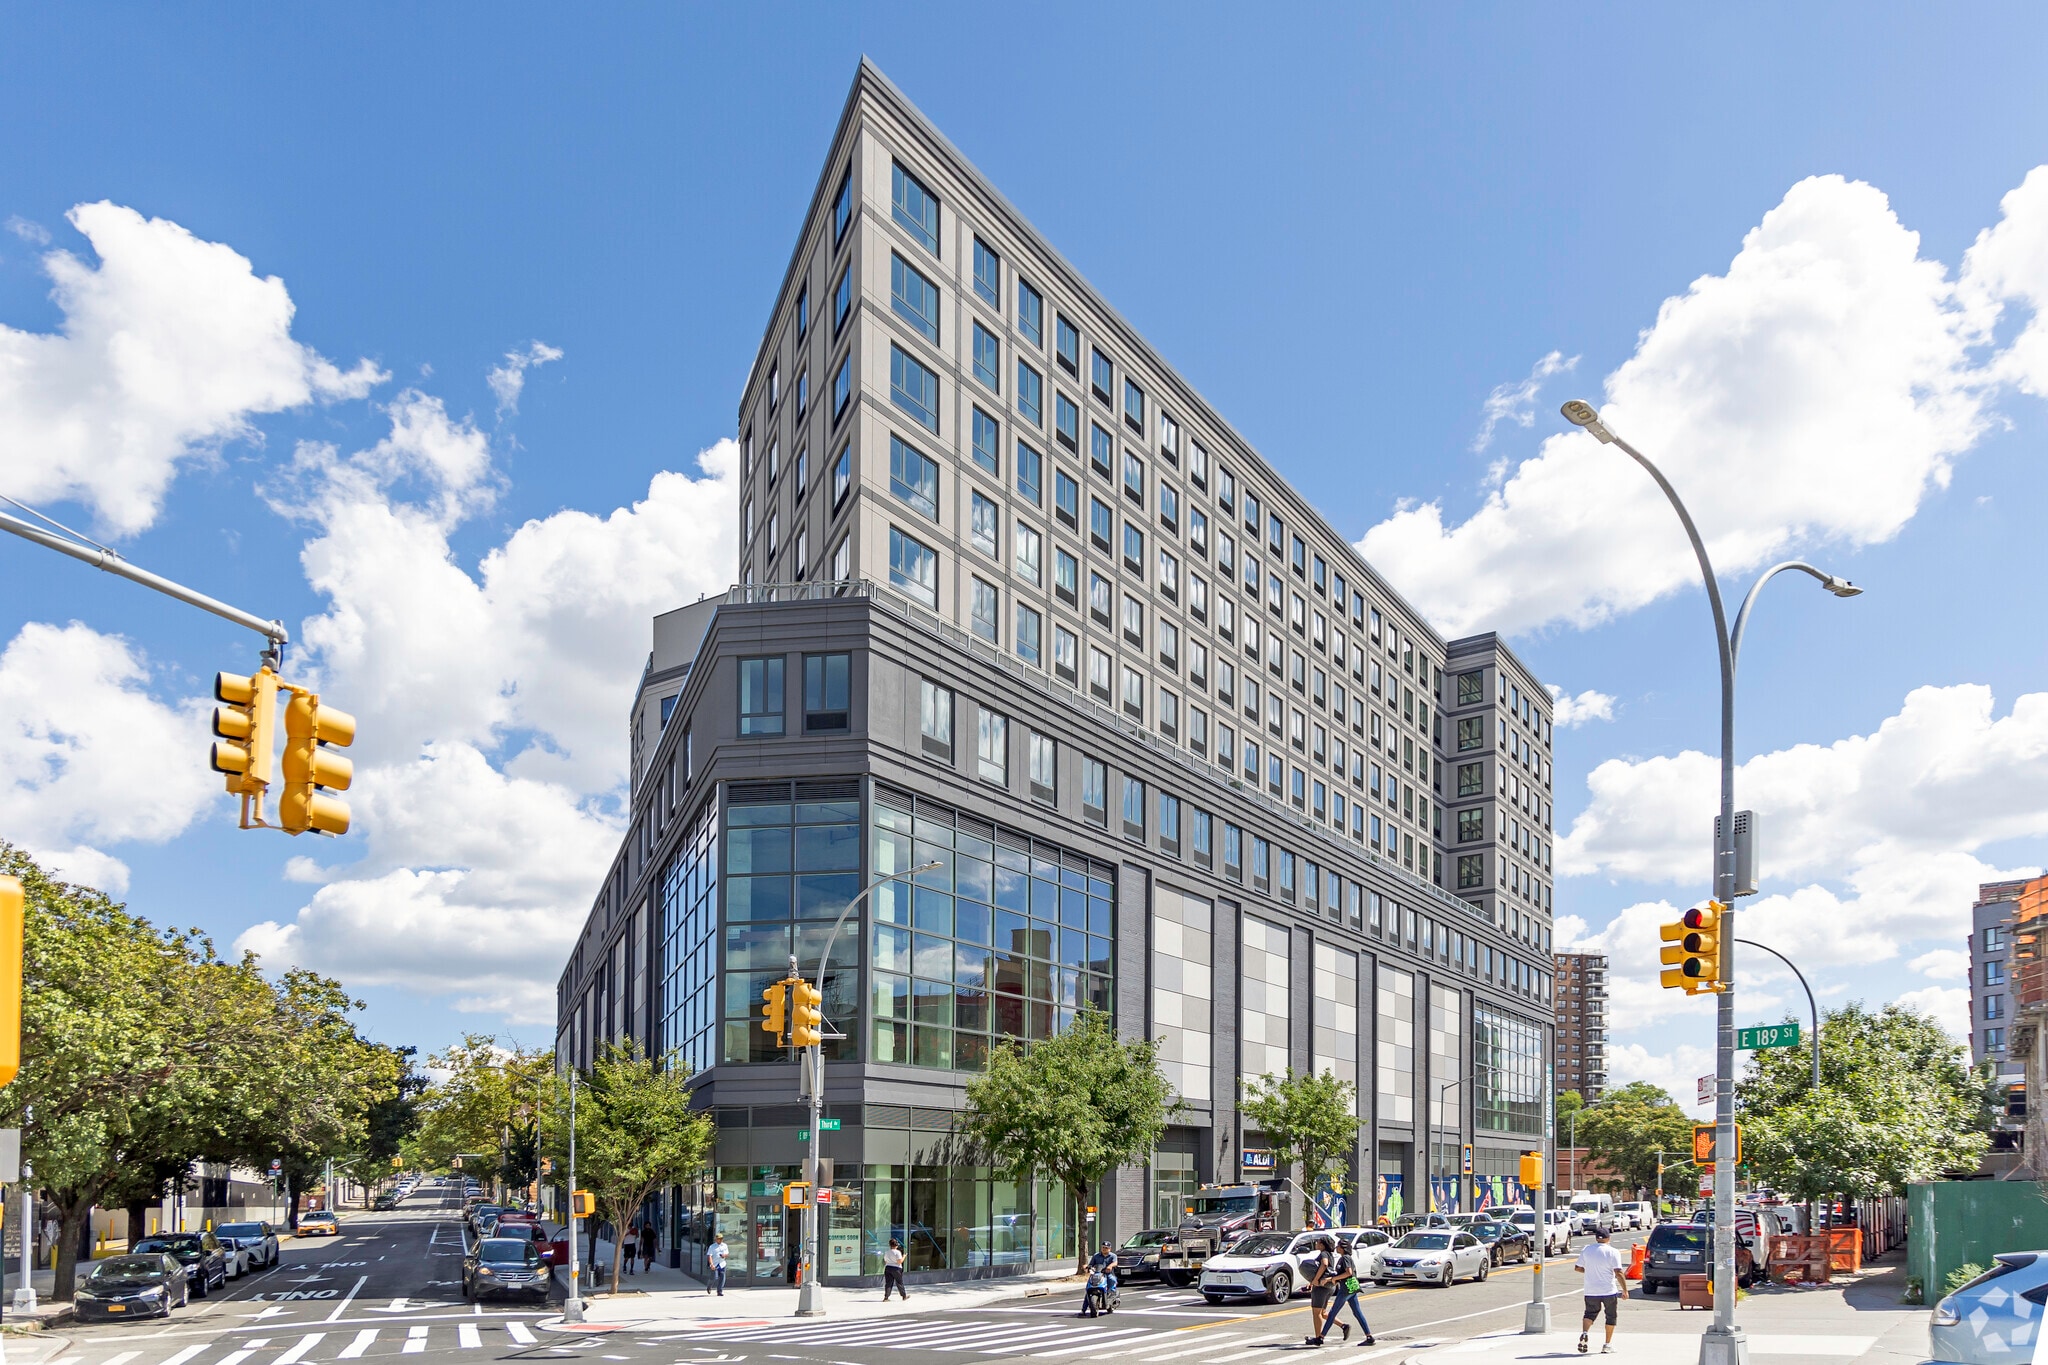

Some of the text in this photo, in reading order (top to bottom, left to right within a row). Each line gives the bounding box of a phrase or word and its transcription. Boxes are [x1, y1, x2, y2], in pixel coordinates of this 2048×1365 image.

[1742, 1027, 1793, 1047] E 189 St
[821, 1120, 833, 1129] Third
[1253, 1154, 1270, 1165] ALDI
[238, 1289, 339, 1302] ONLY
